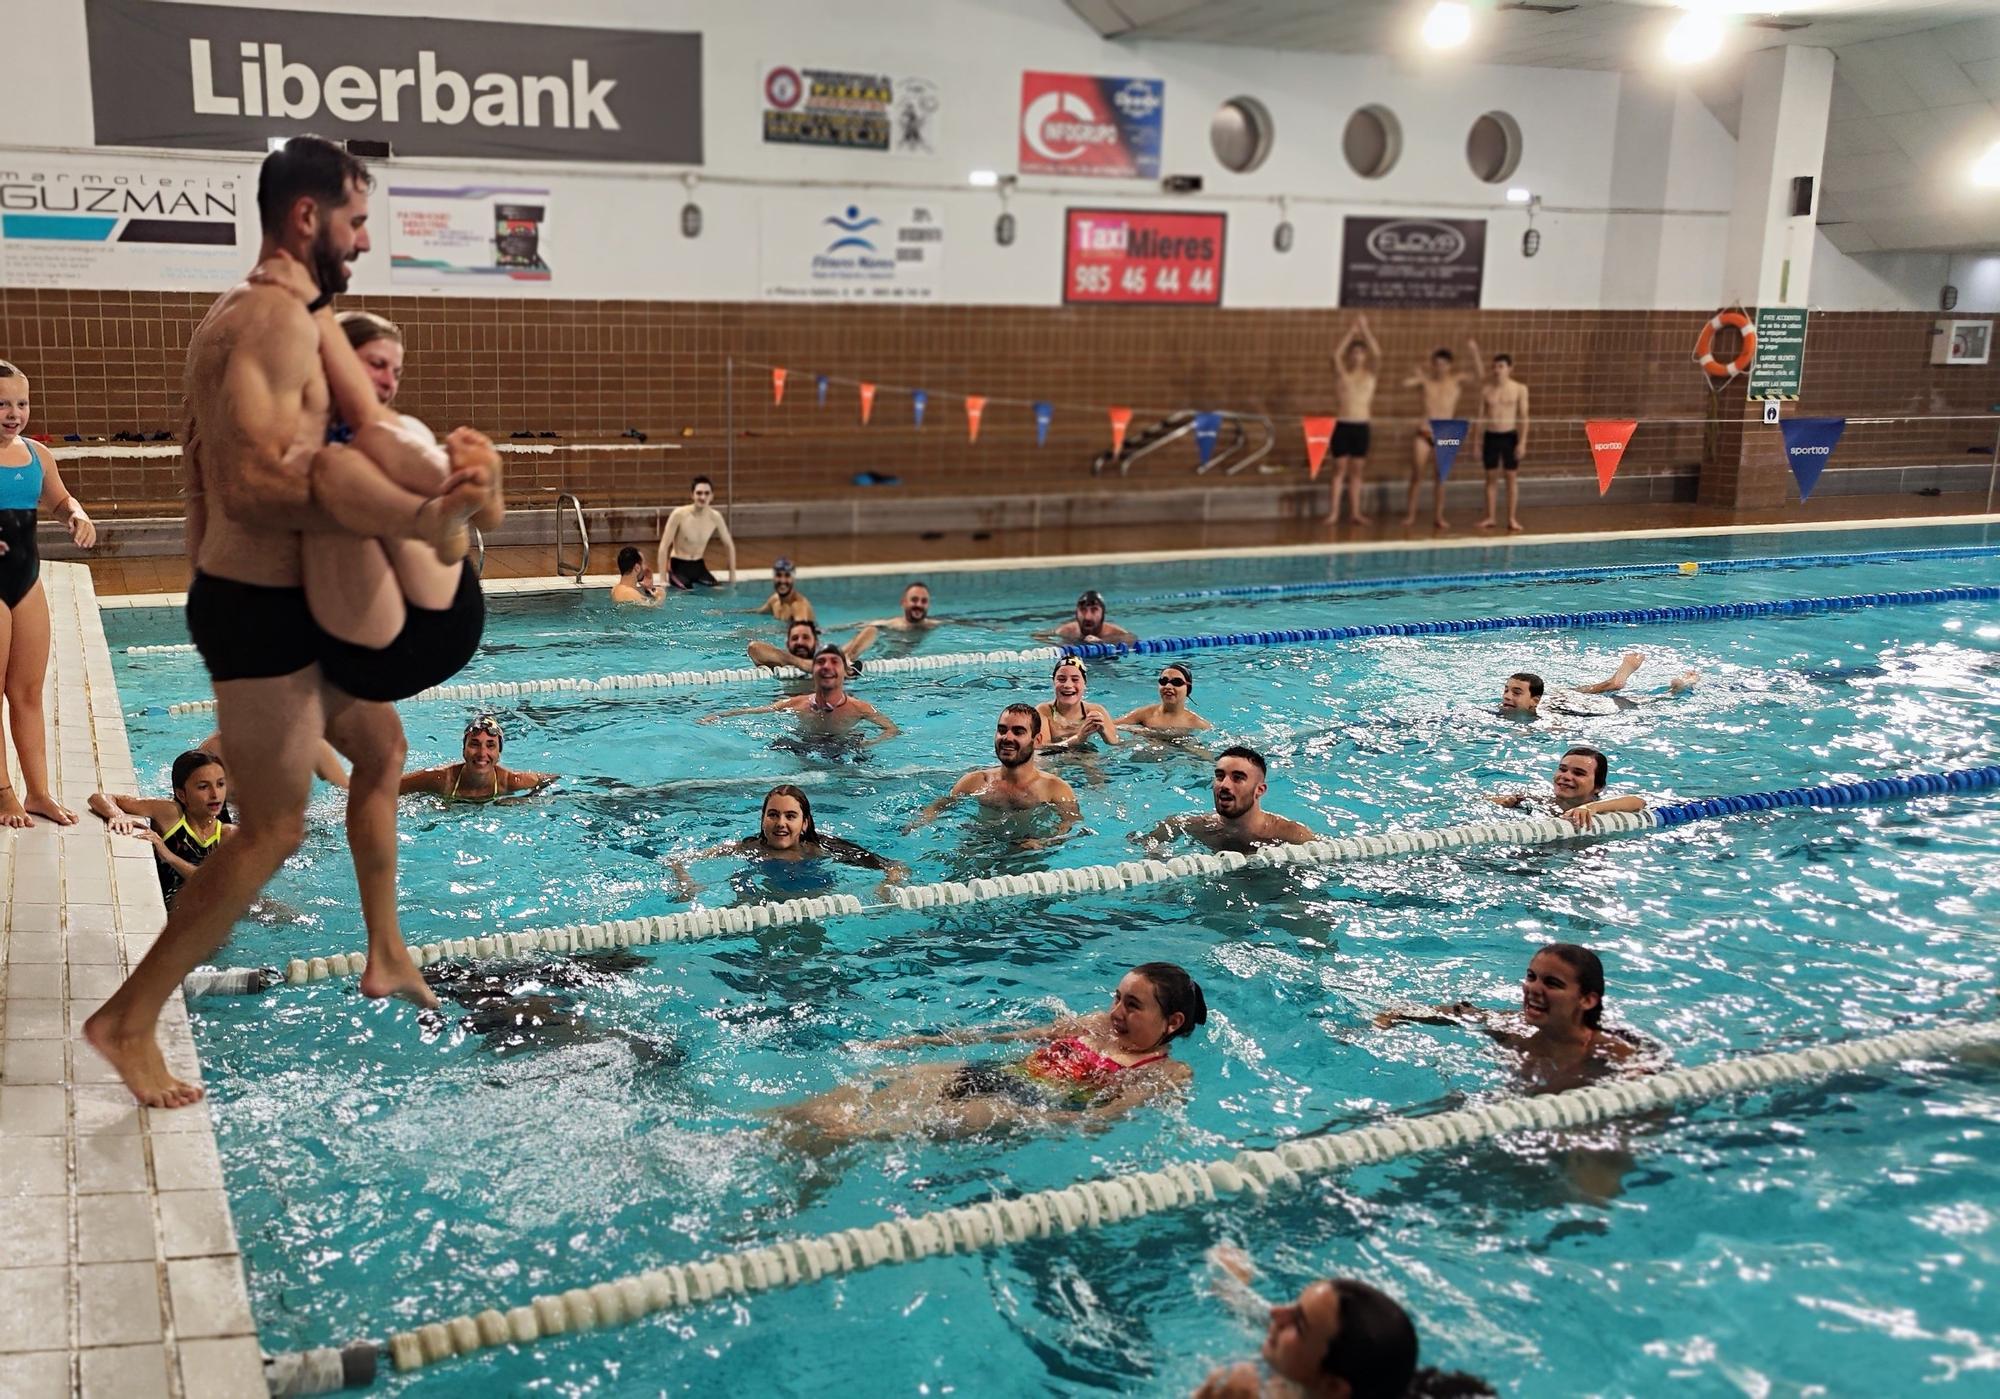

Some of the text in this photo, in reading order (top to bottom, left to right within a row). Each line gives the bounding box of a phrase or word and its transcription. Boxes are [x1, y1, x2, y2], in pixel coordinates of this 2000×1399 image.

[189, 37, 621, 130] Liberbank
[0, 184, 237, 216] GUZMAN
[1075, 264, 1213, 293] 985 46 44 44
[1790, 445, 1830, 457] sport100
